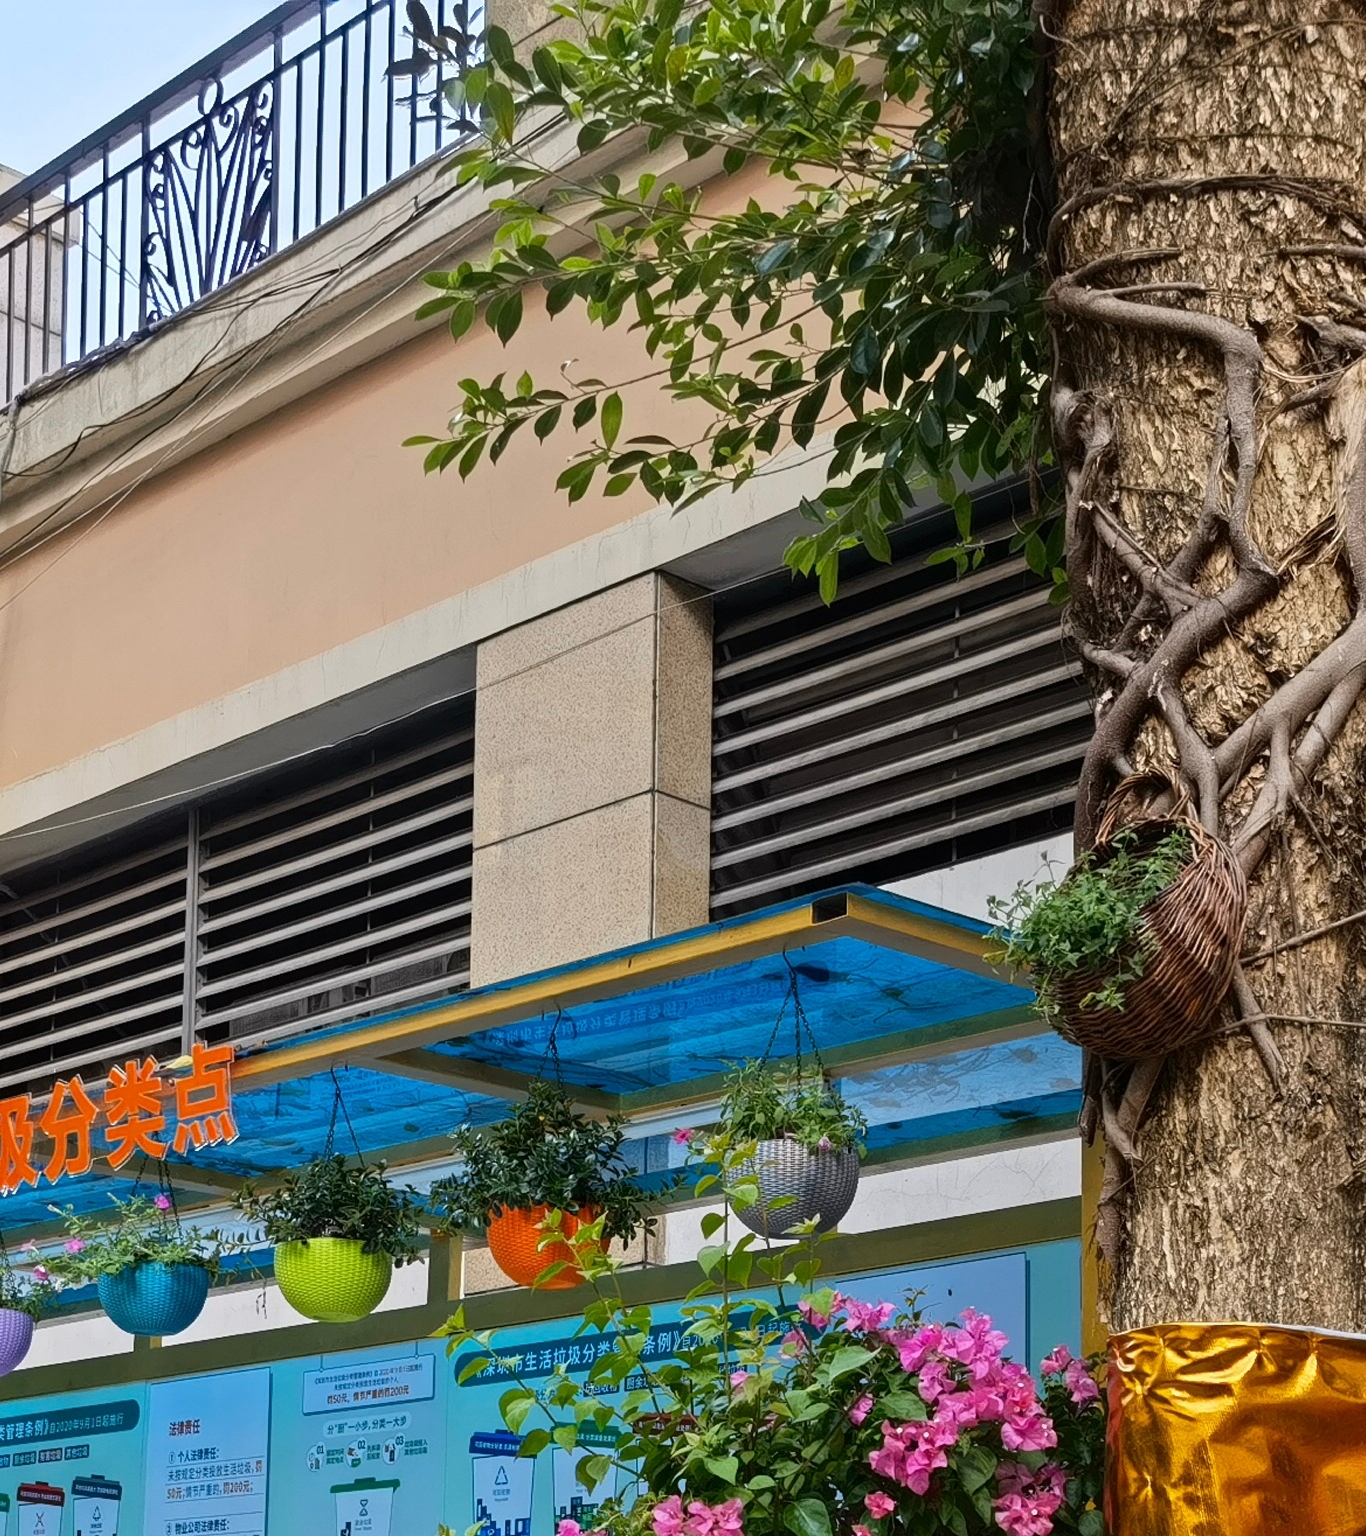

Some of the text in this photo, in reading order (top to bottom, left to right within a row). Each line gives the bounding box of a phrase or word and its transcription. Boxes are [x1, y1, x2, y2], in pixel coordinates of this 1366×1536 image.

[168, 1418, 201, 1437] 法律责任
[357, 1440, 366, 1450] 02
[395, 1435, 404, 1446] 03
[316, 1445, 324, 1455] 01
